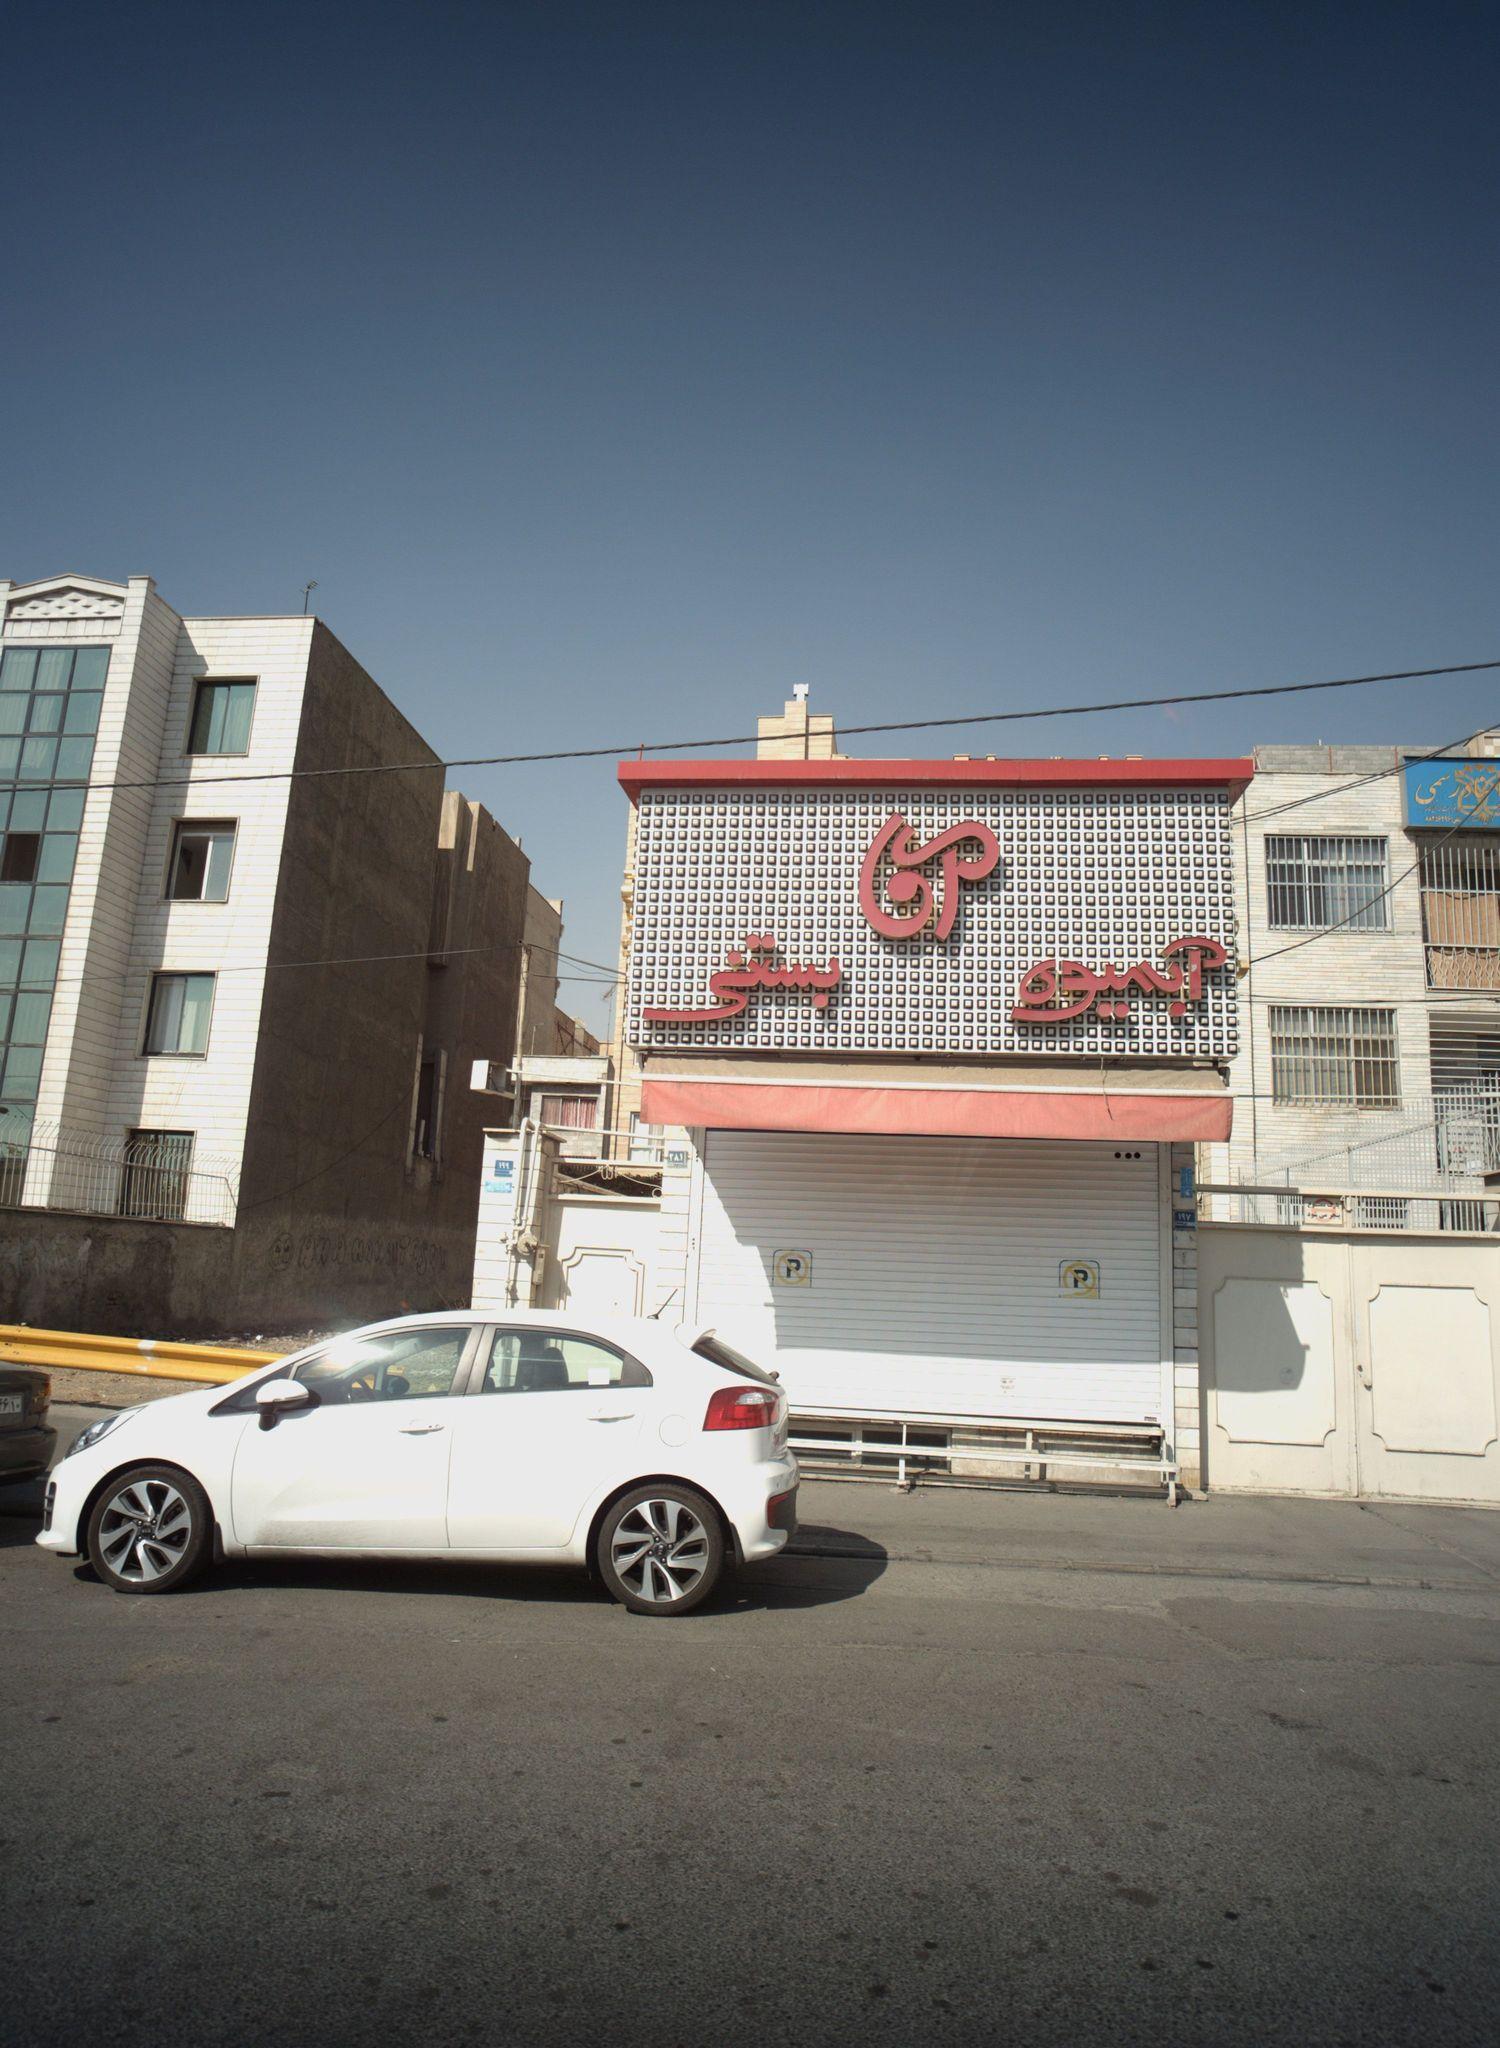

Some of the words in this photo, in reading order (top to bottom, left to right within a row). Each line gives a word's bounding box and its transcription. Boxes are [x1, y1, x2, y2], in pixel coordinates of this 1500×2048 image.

[642, 934, 840, 1022] بستنی
[1011, 936, 1227, 1022] آبمیوه
[786, 1258, 801, 1278] P
[1073, 1269, 1089, 1288] P
